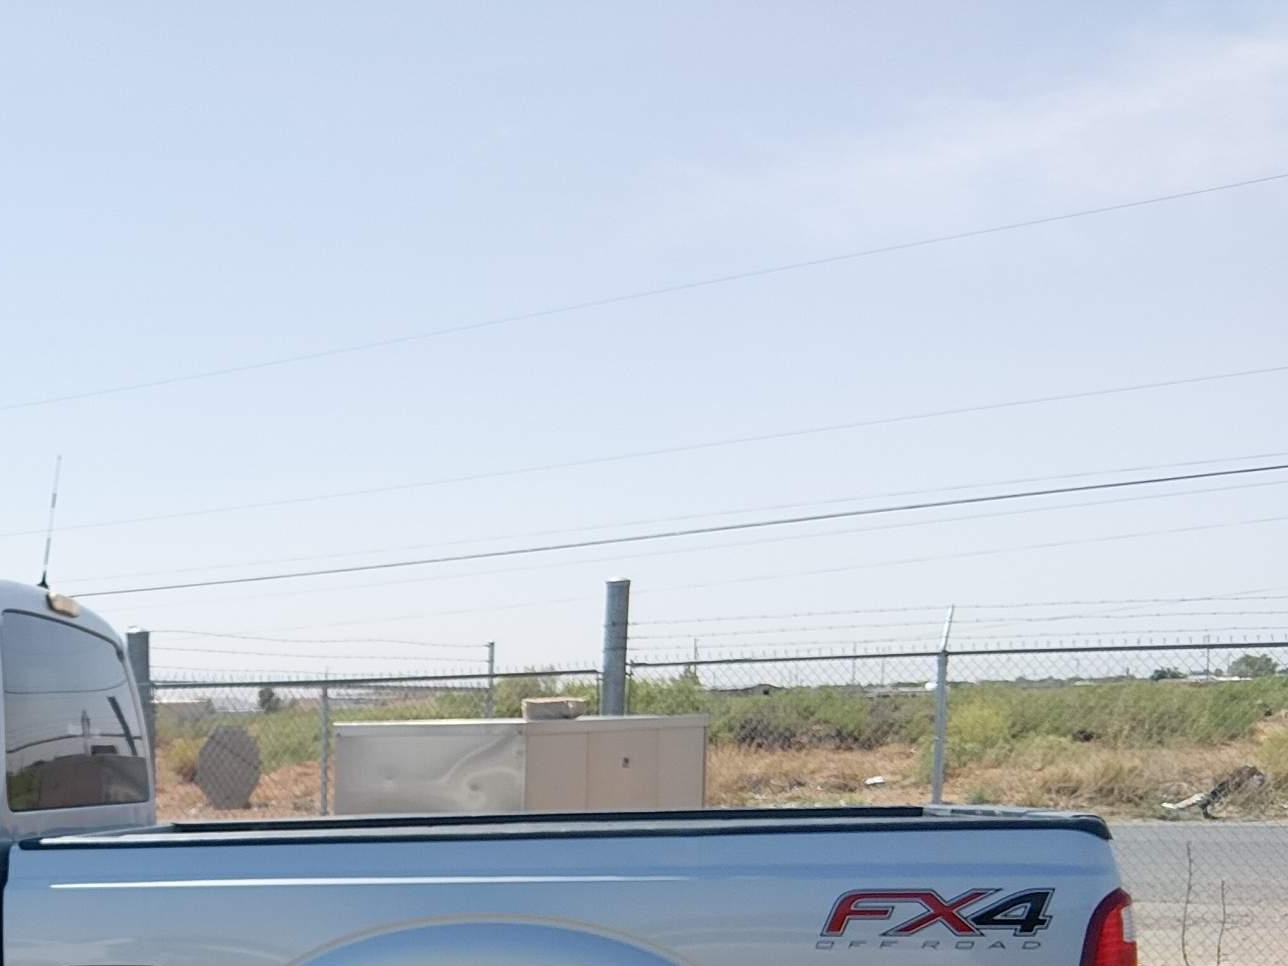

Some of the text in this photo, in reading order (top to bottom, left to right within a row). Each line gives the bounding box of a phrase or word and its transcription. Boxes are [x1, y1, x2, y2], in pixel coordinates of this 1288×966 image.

[820, 888, 1055, 937] FX4
[815, 940, 1043, 950] OFF ROAD
